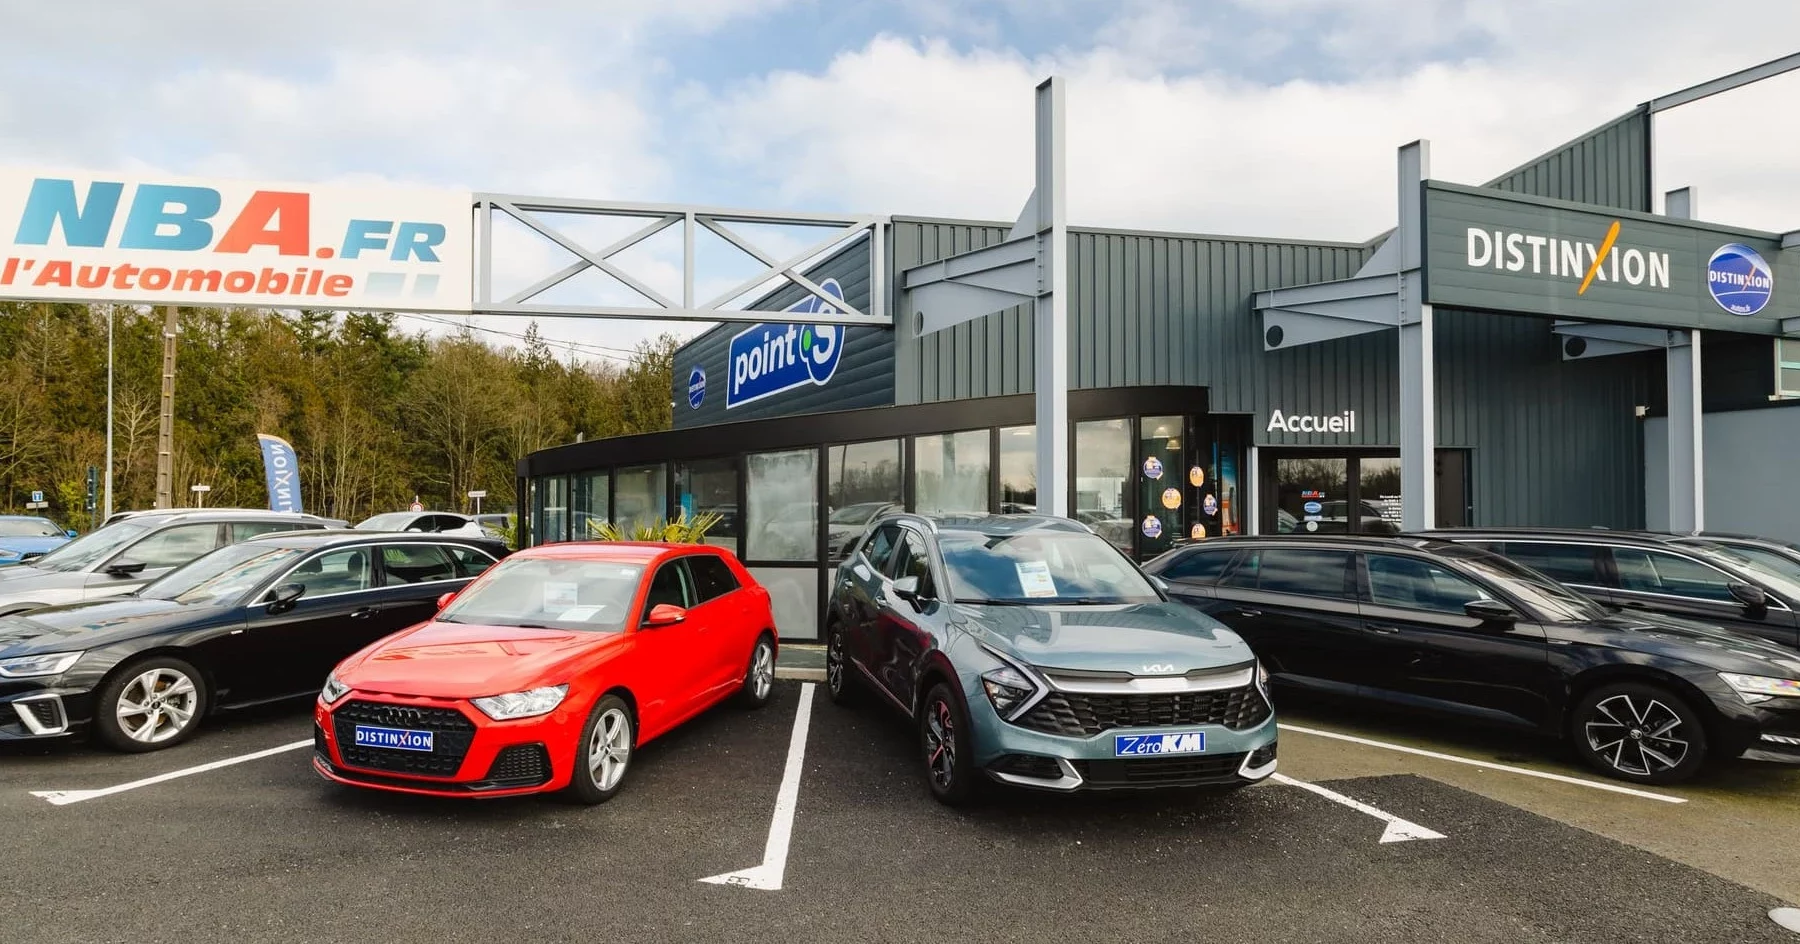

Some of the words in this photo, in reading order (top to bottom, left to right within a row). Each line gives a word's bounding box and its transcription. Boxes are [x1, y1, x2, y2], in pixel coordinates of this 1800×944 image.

[14, 178, 446, 263] NBA.FR
[0, 258, 354, 297] l'Automobile
[1468, 221, 1670, 296] DISTINXION
[1710, 265, 1770, 291] DISTINXION
[734, 323, 797, 395] point
[1267, 409, 1355, 432] Accueil
[356, 730, 431, 748] DISTINXION
